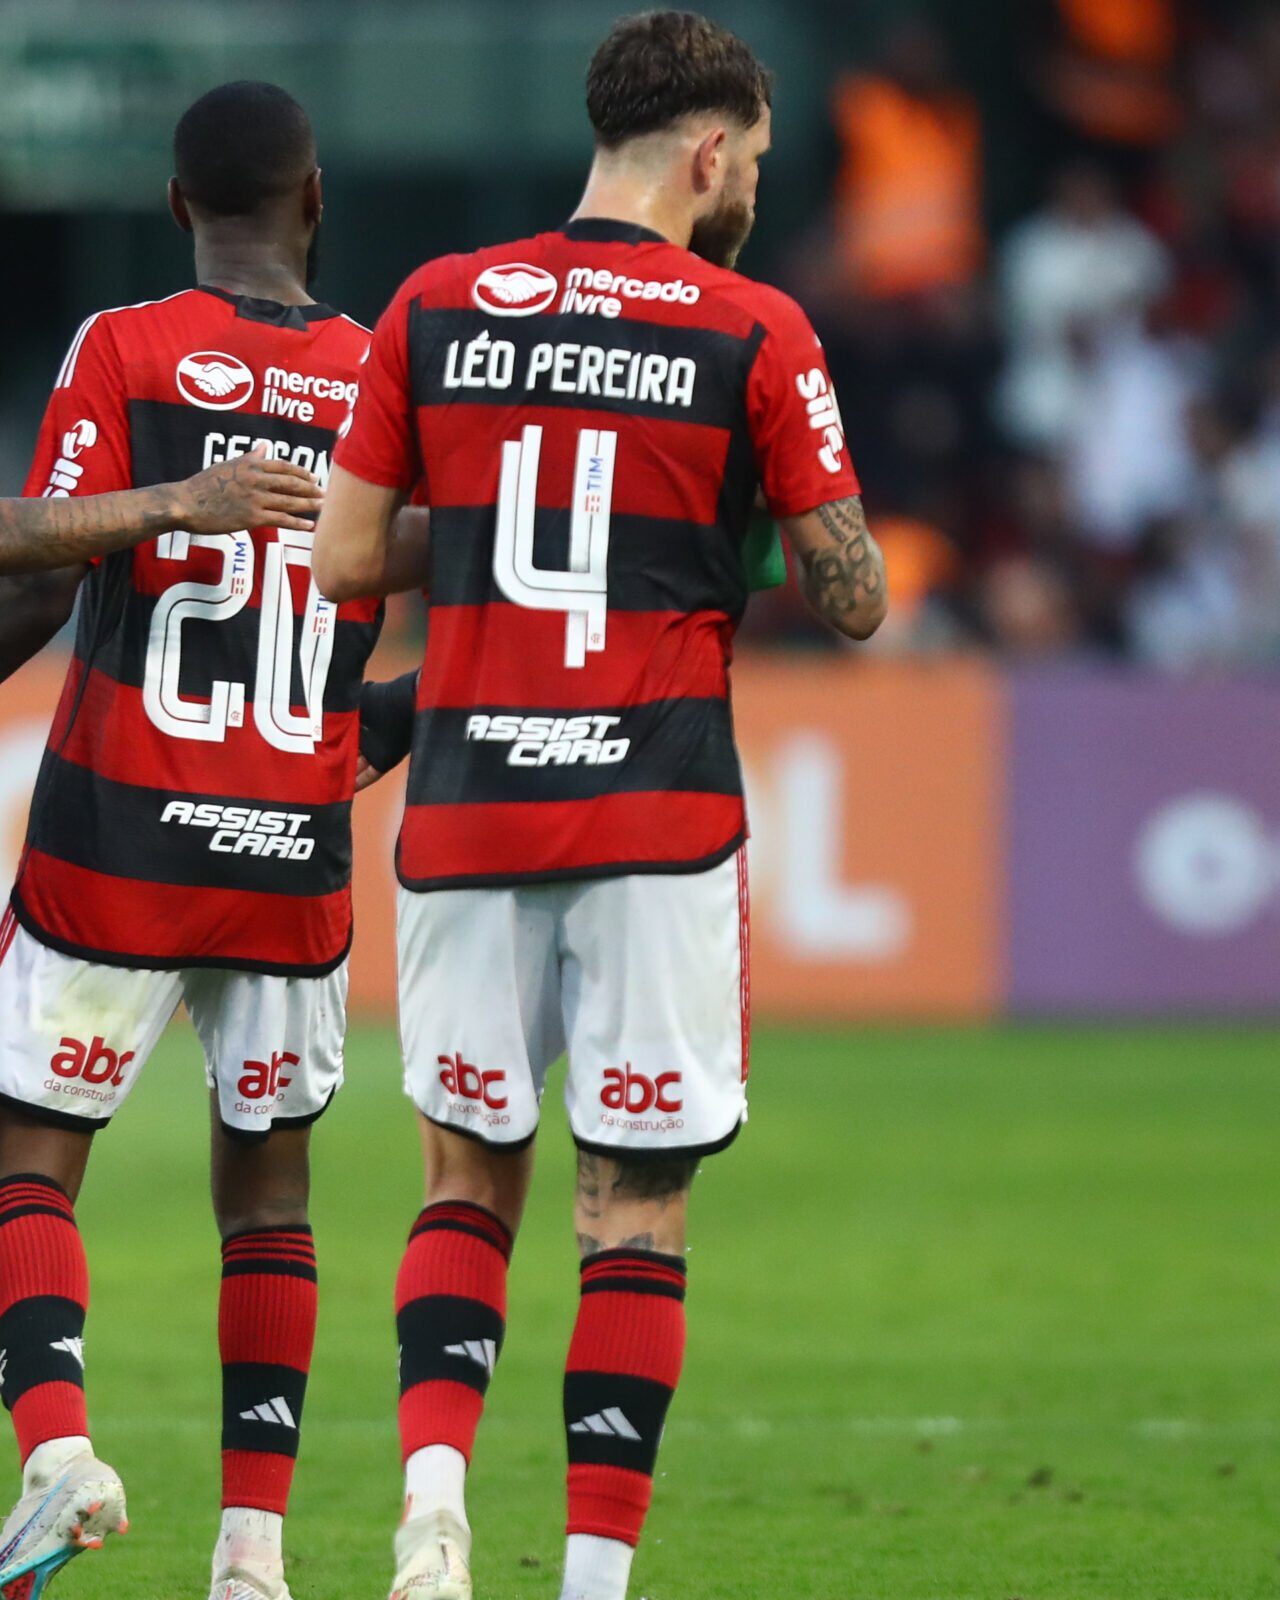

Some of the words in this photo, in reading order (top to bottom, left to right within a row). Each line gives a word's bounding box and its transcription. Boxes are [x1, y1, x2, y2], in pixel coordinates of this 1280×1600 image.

[565, 266, 701, 305] mercado
[559, 290, 622, 318] livre
[443, 330, 515, 390] LÉO
[525, 343, 697, 407] PEREIRA
[261, 387, 315, 423] livre
[587, 457, 603, 490] TIM
[232, 541, 247, 573] TIM
[492, 424, 618, 669] 4
[142, 527, 338, 754] 20
[466, 715, 622, 742] ASSIST
[507, 738, 631, 767] CARD
[160, 800, 312, 836] ASSIST
[209, 829, 316, 861] CARD
[43, 1078, 62, 1092] da
[437, 1052, 508, 1110] abc
[599, 1061, 684, 1114] abc
[234, 1100, 252, 1114] da
